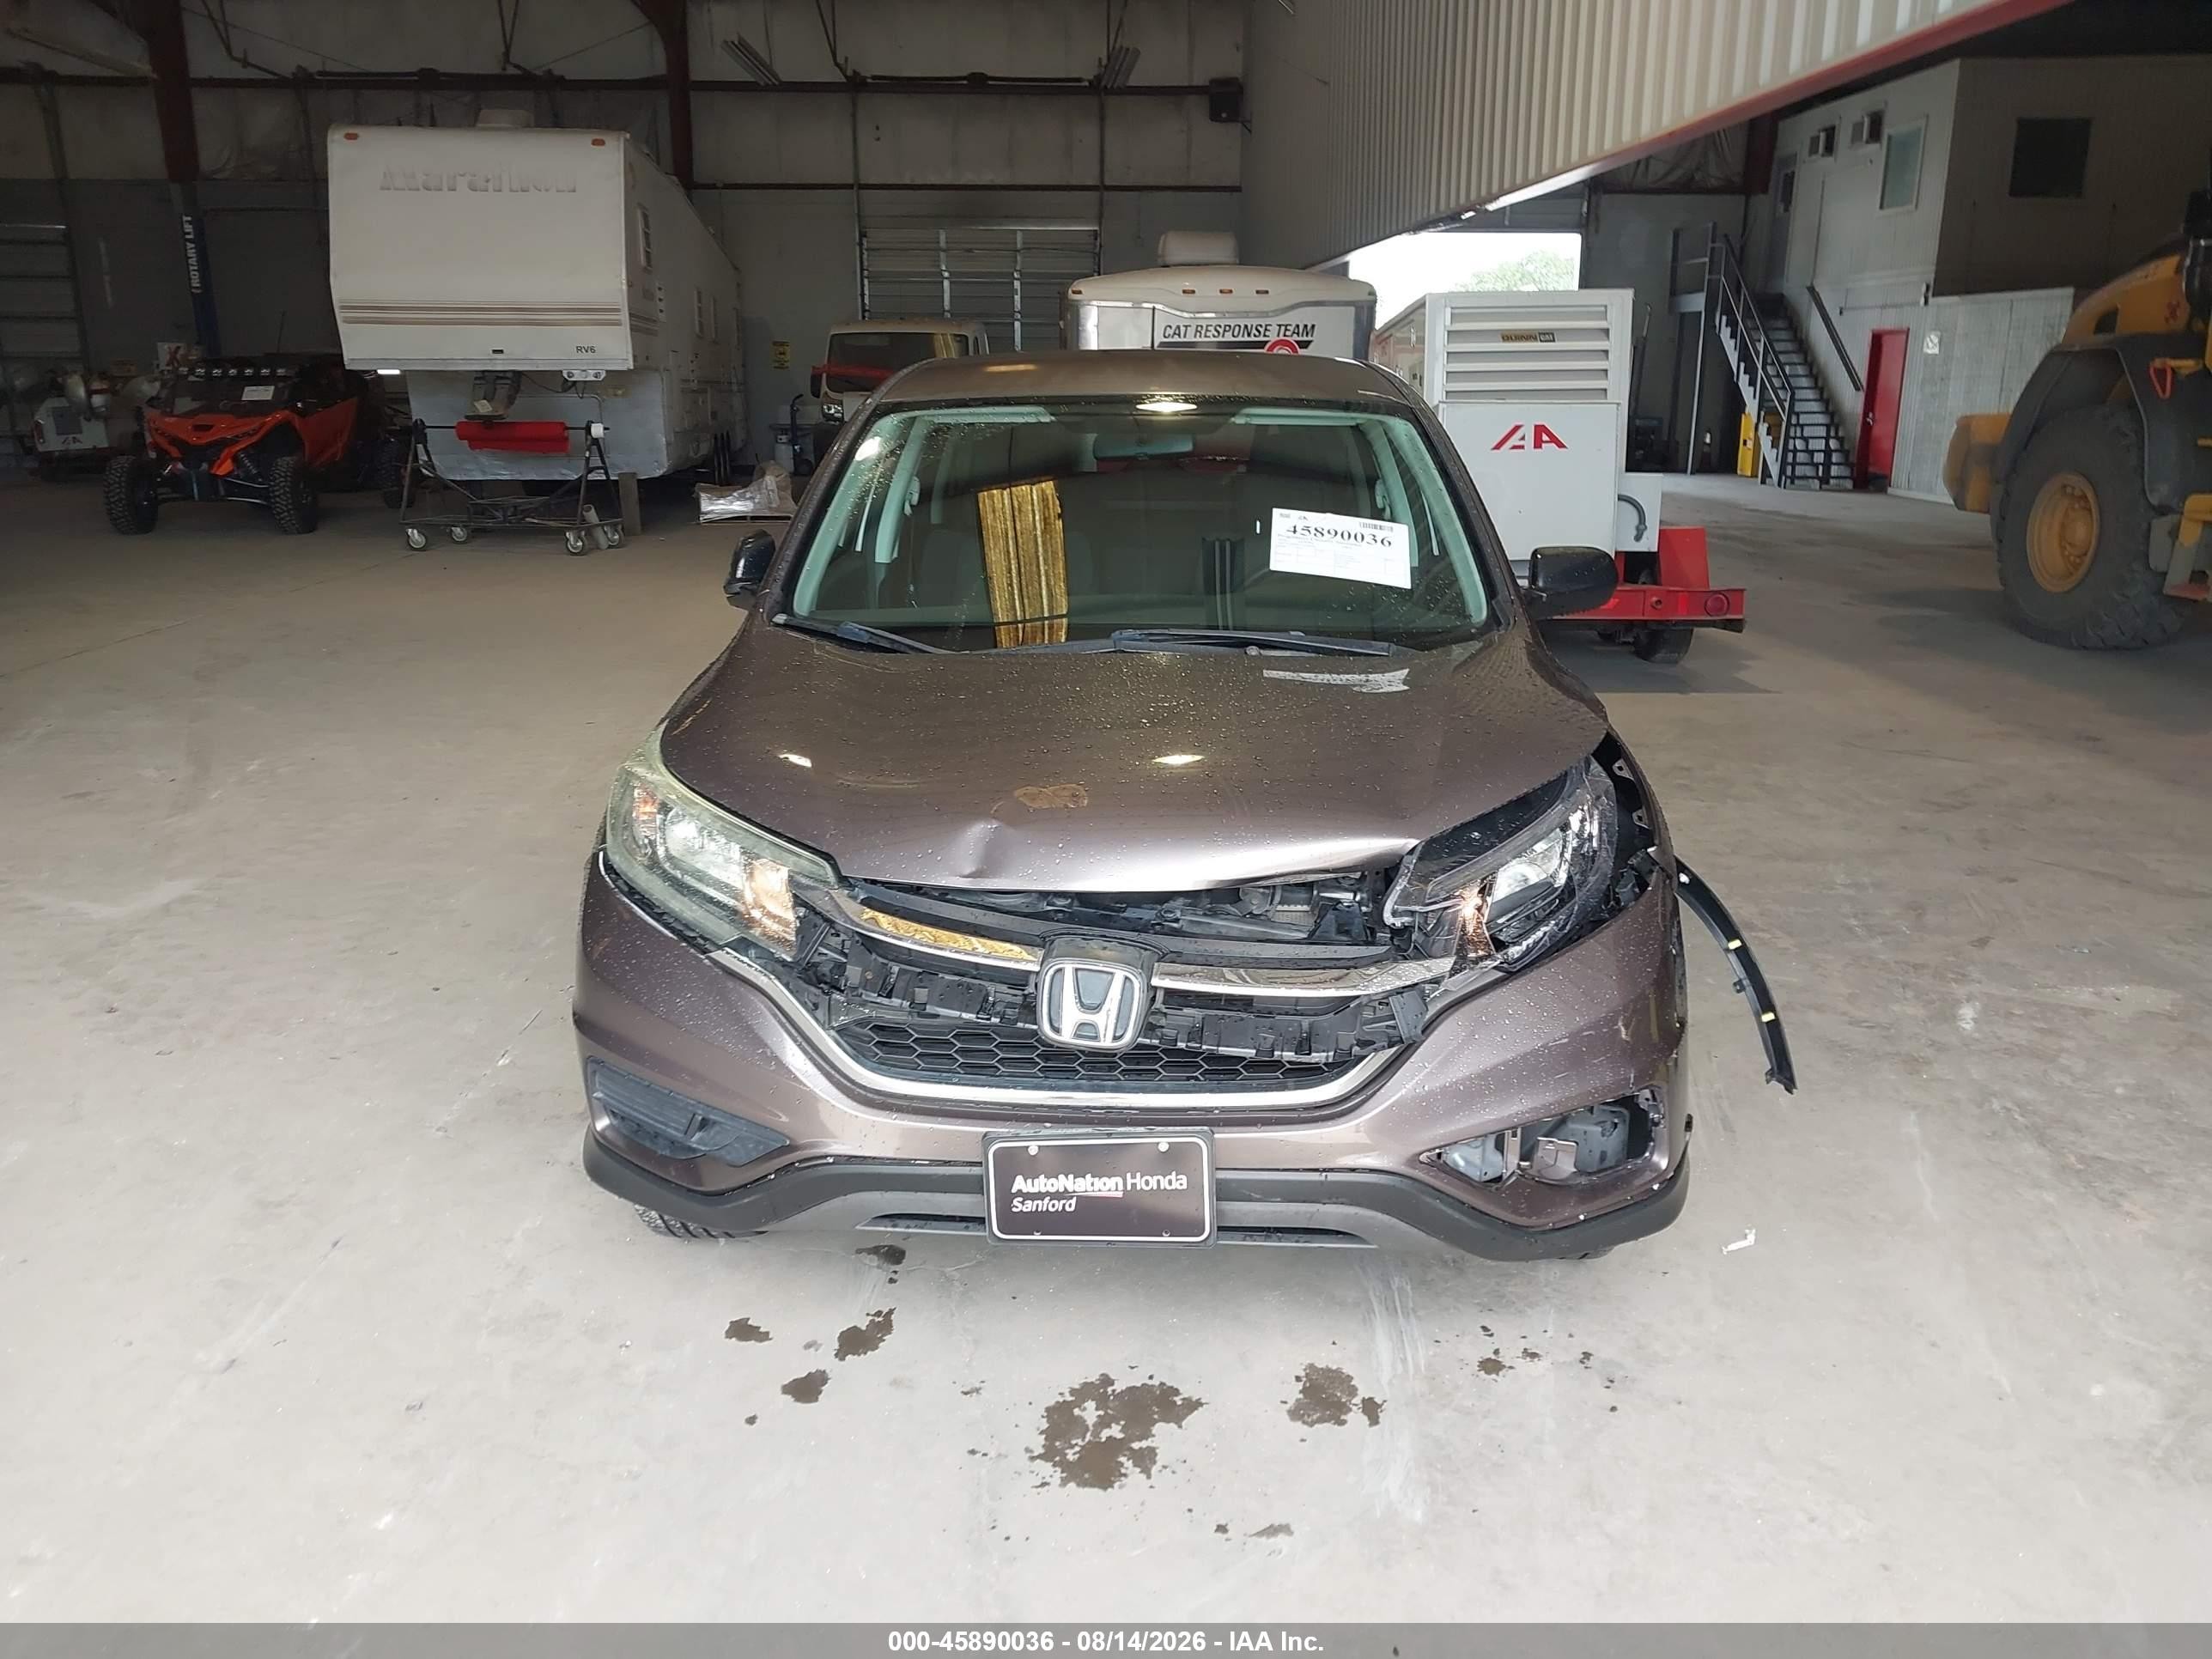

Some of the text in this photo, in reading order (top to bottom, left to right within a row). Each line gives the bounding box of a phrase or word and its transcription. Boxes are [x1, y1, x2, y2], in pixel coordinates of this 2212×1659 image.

[182, 214, 201, 288] ROTARY LIFT
[1163, 323, 1316, 339] CAT RESPONSE TEAM
[575, 345, 597, 354] RV6
[1286, 524, 1393, 548] 45890036
[1011, 1170, 1188, 1194] AutoNation Honda
[1011, 1196, 1078, 1213] Sanford
